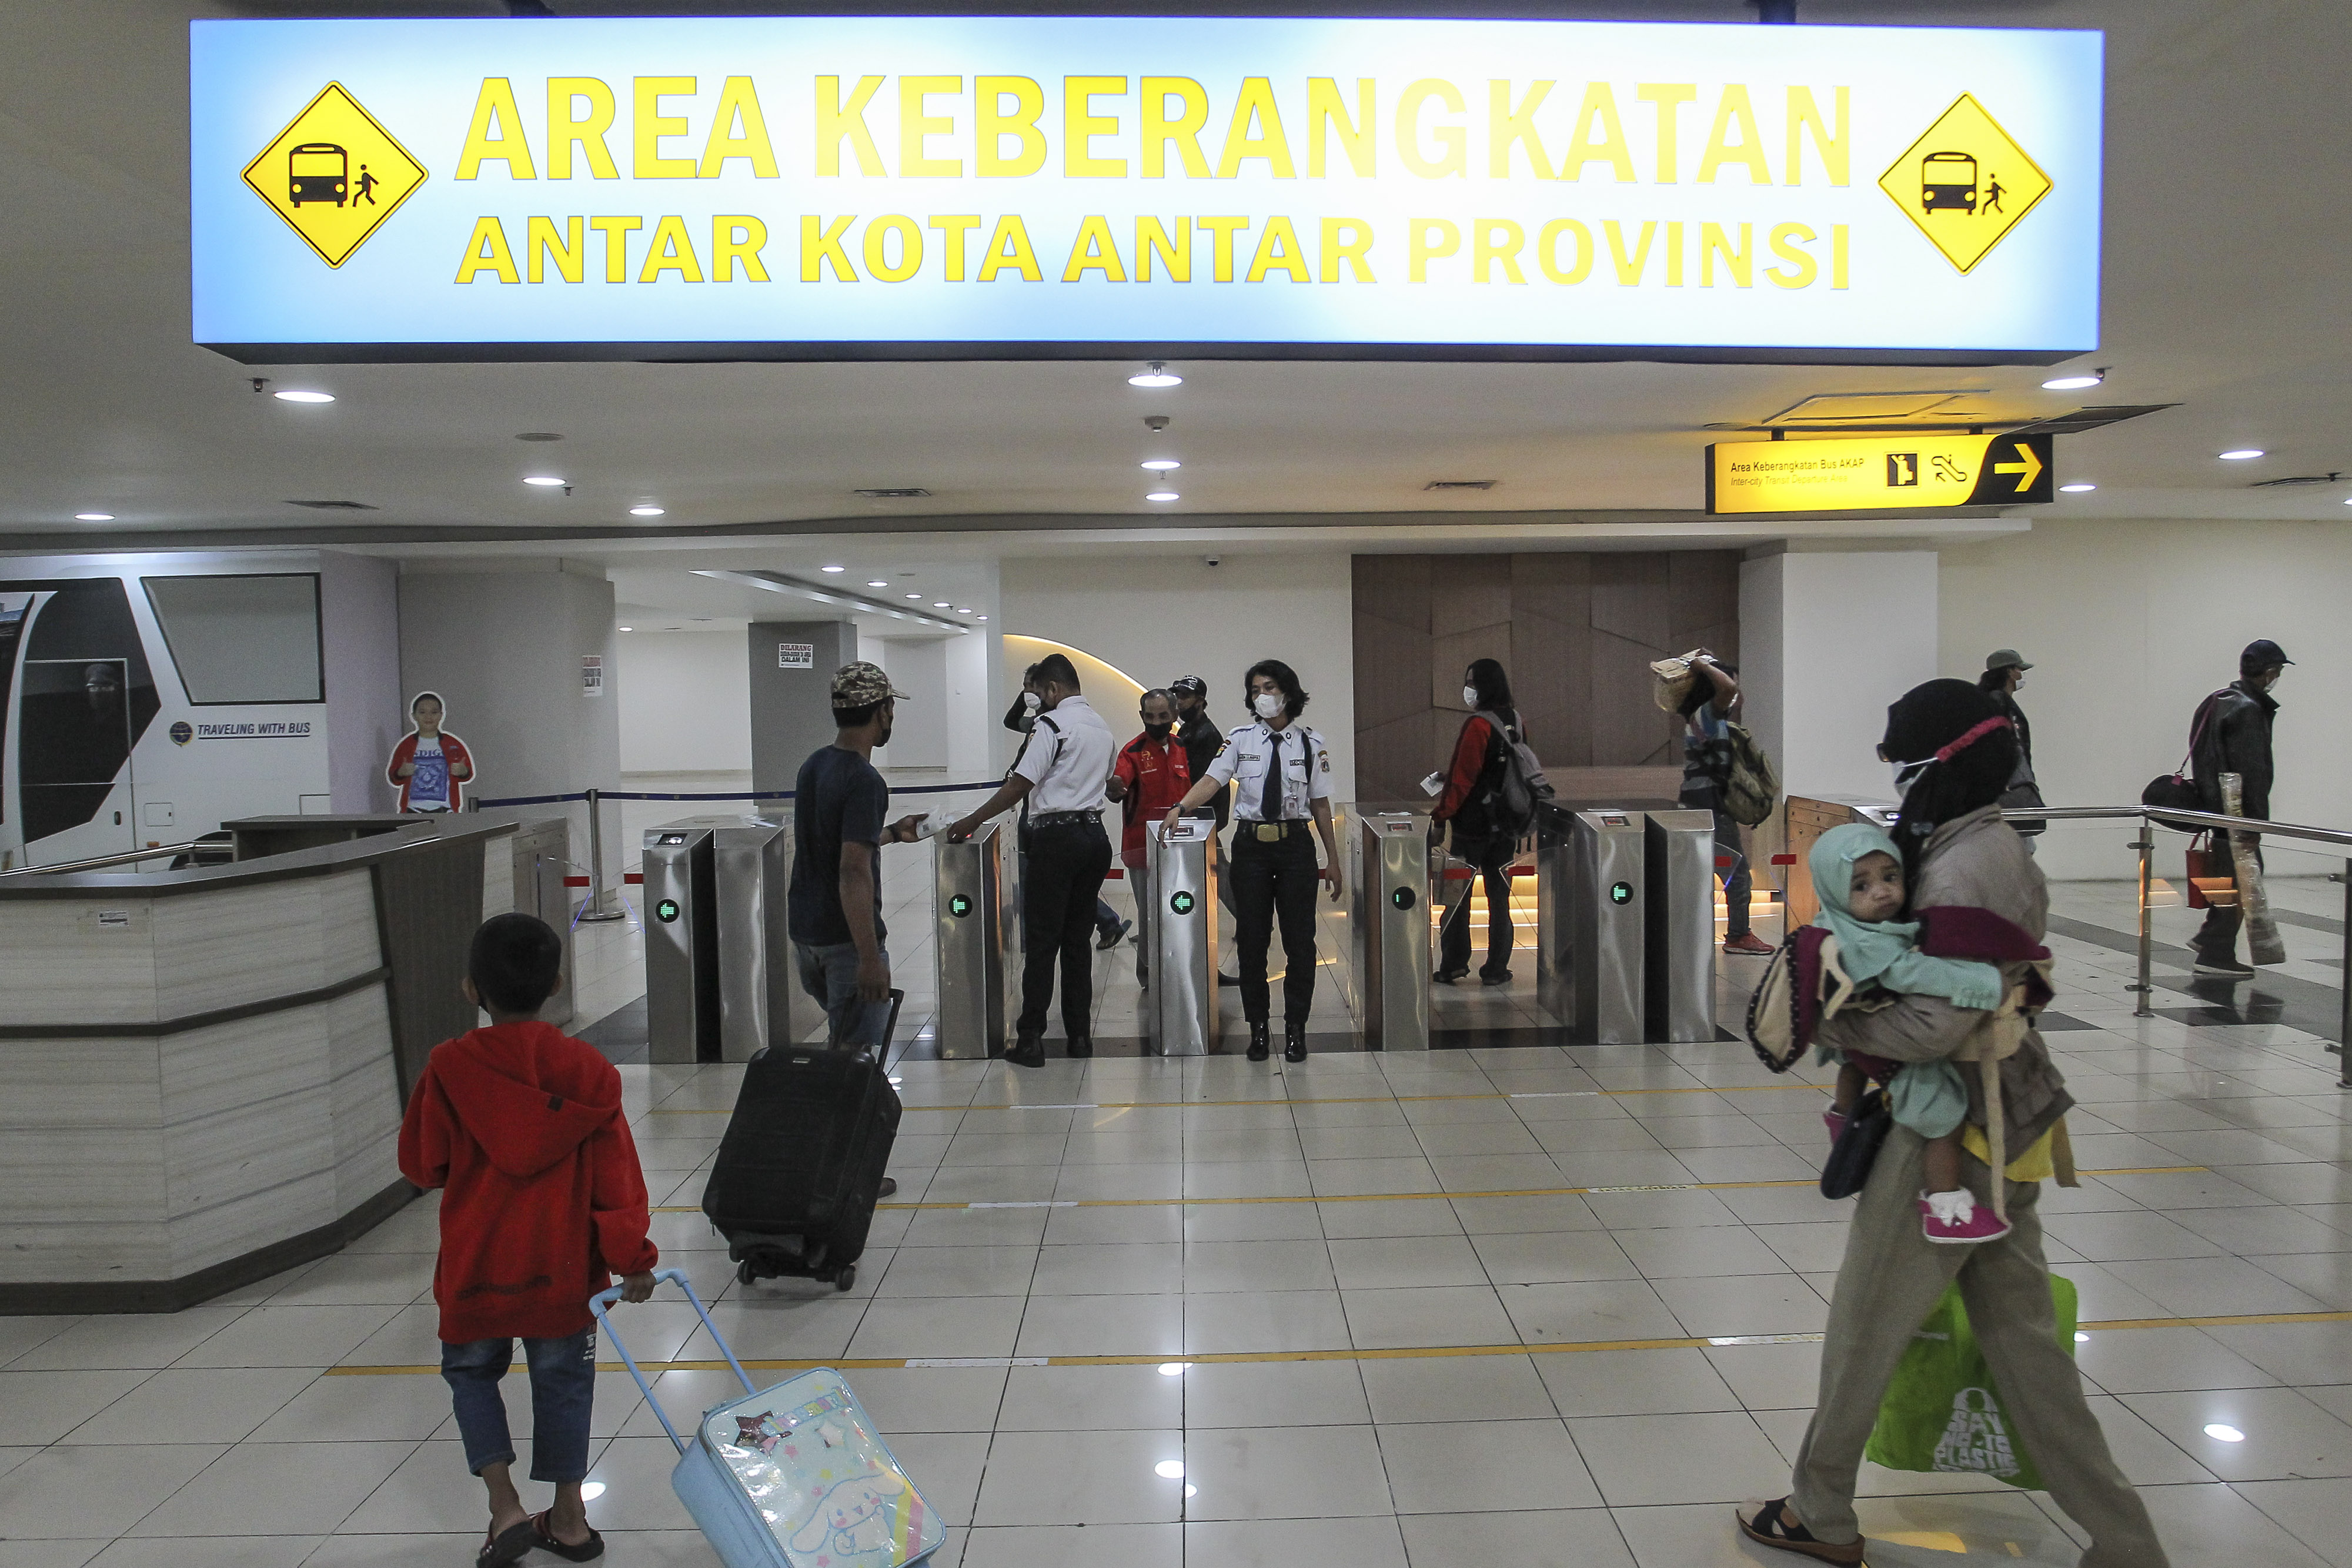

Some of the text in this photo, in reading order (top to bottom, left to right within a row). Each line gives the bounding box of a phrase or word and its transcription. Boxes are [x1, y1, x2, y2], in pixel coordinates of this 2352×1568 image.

[453, 74, 1850, 187] AREA KEBERANGKATAN
[453, 213, 1850, 290] ANTAR KOTA ANTAR PROVINSI
[1731, 458, 1864, 473] Area Keberangkatan Bus AKAP
[1730, 477, 1763, 487] Inter-city
[1765, 476, 1790, 484] Transit
[198, 722, 310, 735] TRAVELING WITH BUS
